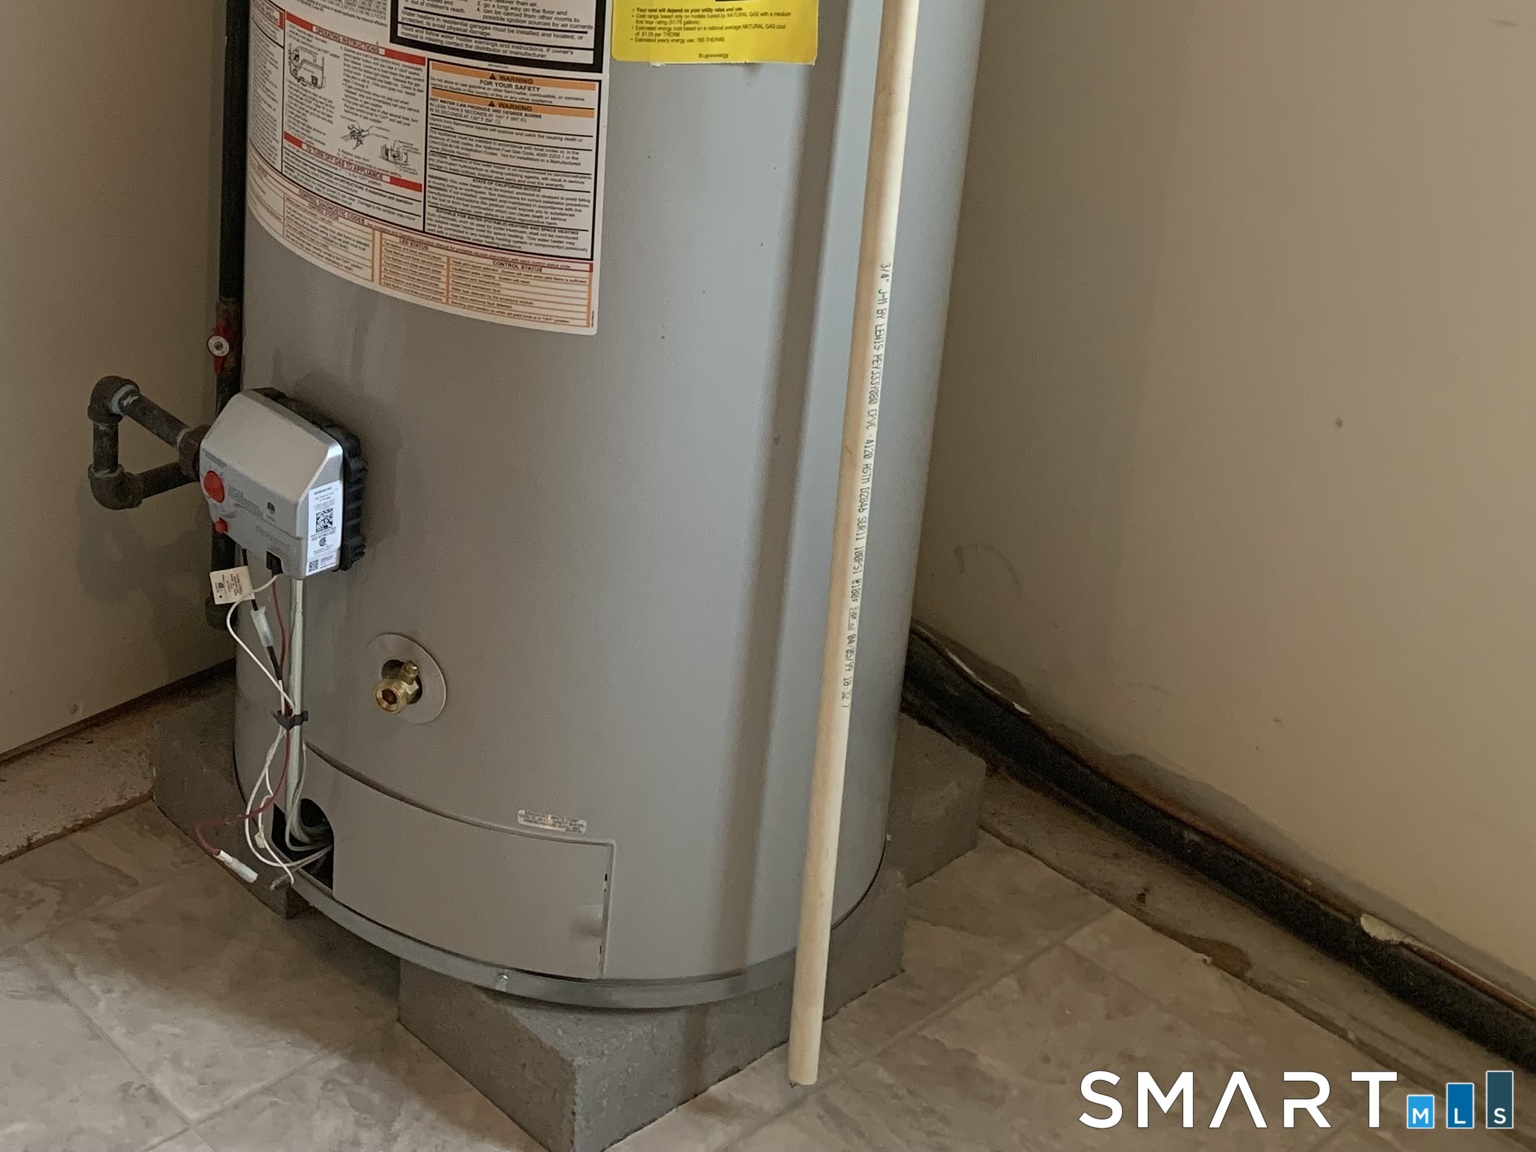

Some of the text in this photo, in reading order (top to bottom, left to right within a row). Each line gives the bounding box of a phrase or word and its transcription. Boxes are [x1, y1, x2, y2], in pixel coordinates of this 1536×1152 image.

[498, 74, 533, 85] WARNING
[494, 81, 512, 89] YOUR
[514, 84, 540, 92] SAFETY
[498, 102, 531, 111] WARNING
